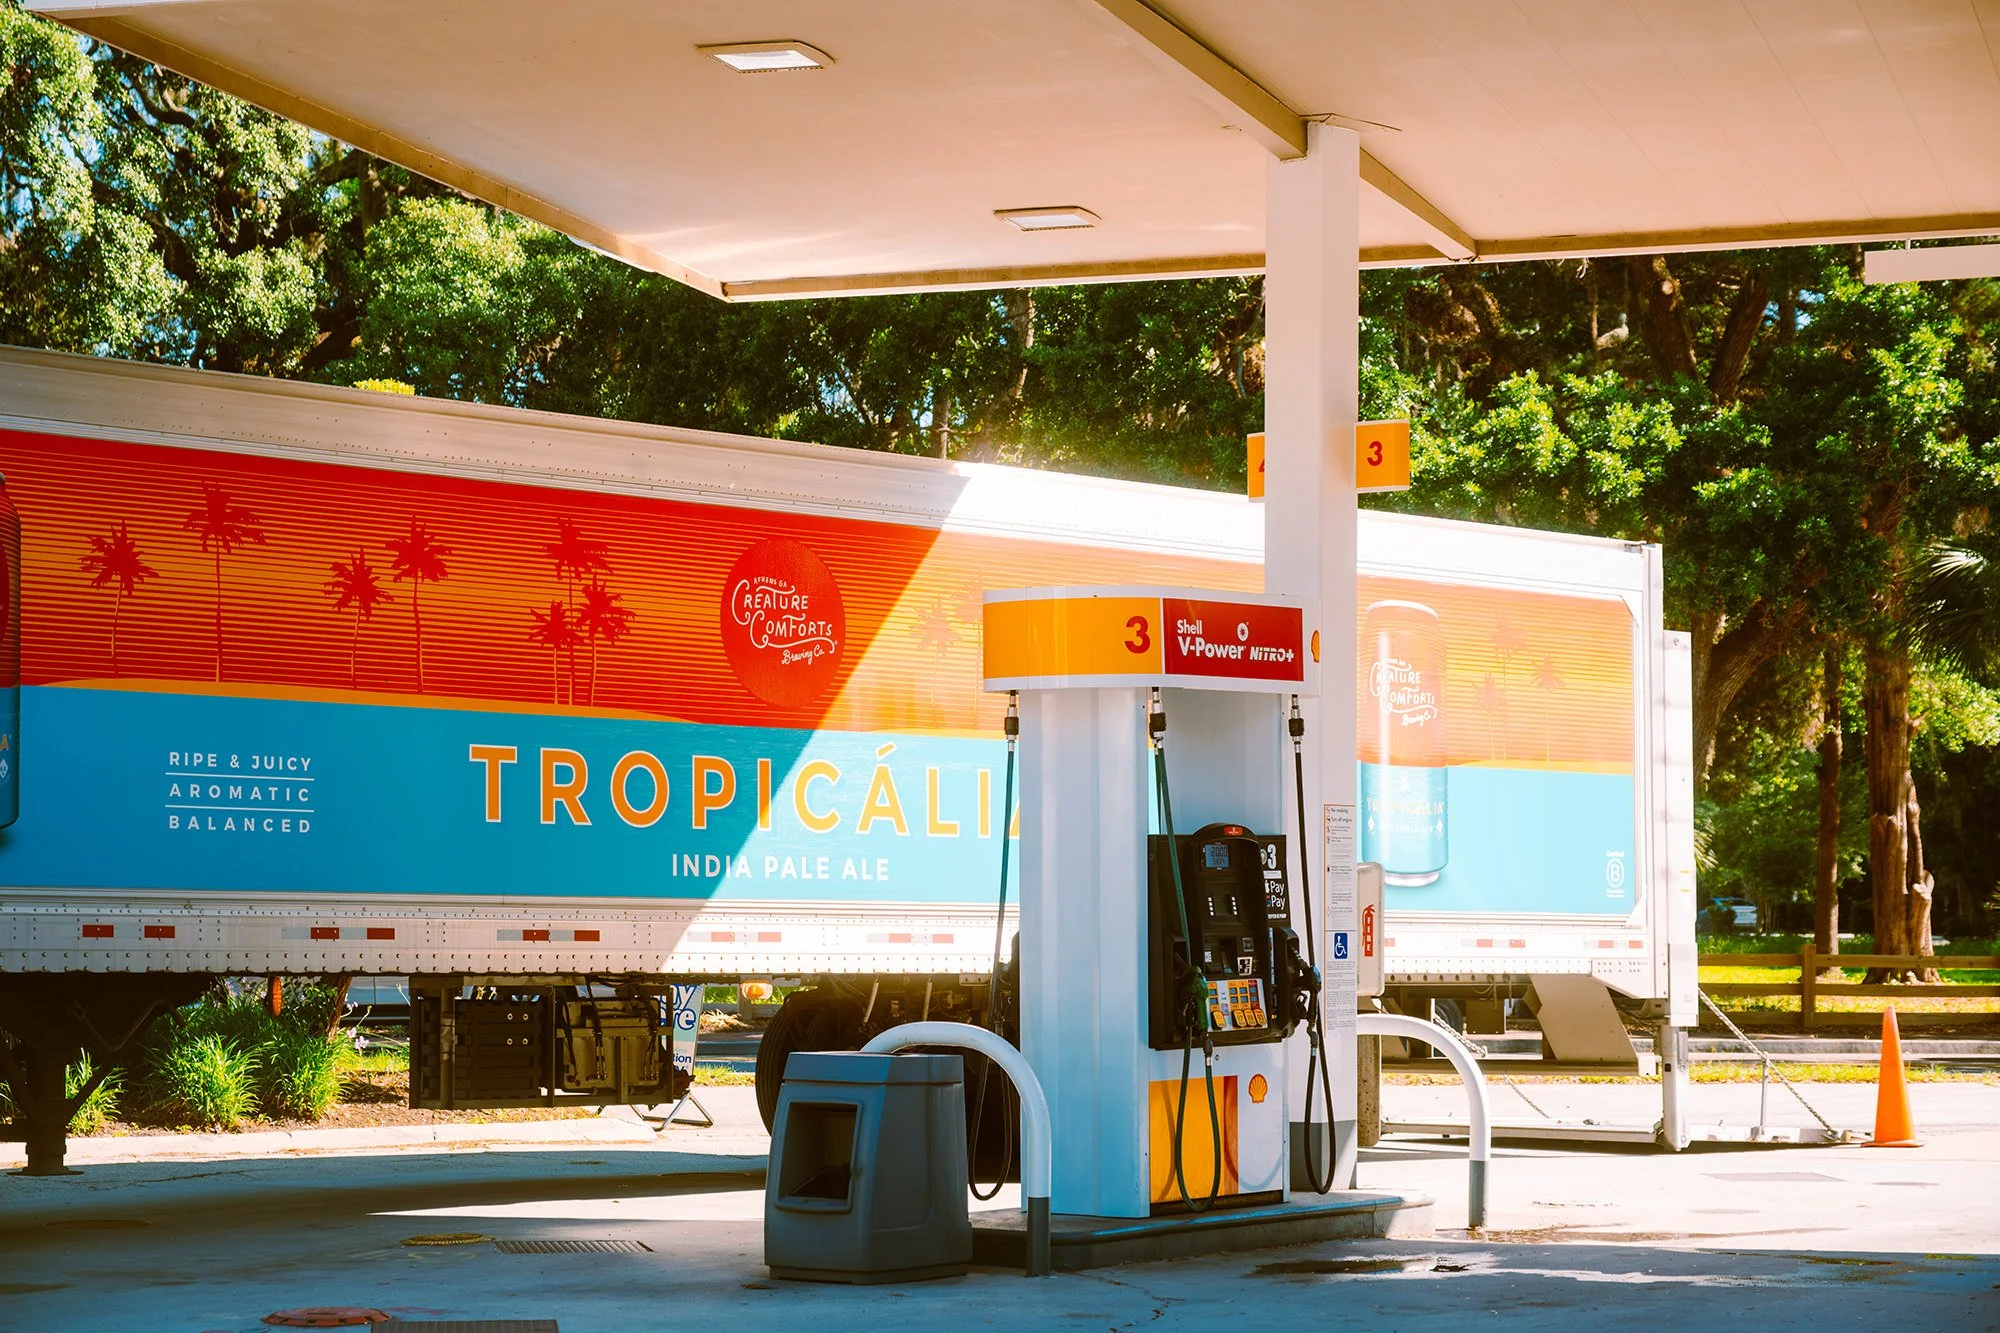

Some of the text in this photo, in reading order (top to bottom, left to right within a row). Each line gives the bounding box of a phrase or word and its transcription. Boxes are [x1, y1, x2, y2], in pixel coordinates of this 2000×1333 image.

[1366, 440, 1383, 467] 3
[731, 579, 809, 626] CREATURE
[750, 610, 834, 649] COMFORTS
[1124, 615, 1151, 654] 3
[1176, 619, 1203, 635] Shell
[781, 649, 813, 665] Brewing
[1177, 635, 1244, 660] V-Power
[169, 751, 312, 772] RIPE & JUICY
[169, 783, 309, 802] AROMATIC
[169, 815, 311, 833] BALANCED
[672, 853, 890, 882] INDIA PALE ALE
[1267, 844, 1277, 869] 3
[1270, 880, 1285, 896] Pay
[1271, 895, 1286, 910] Pay
